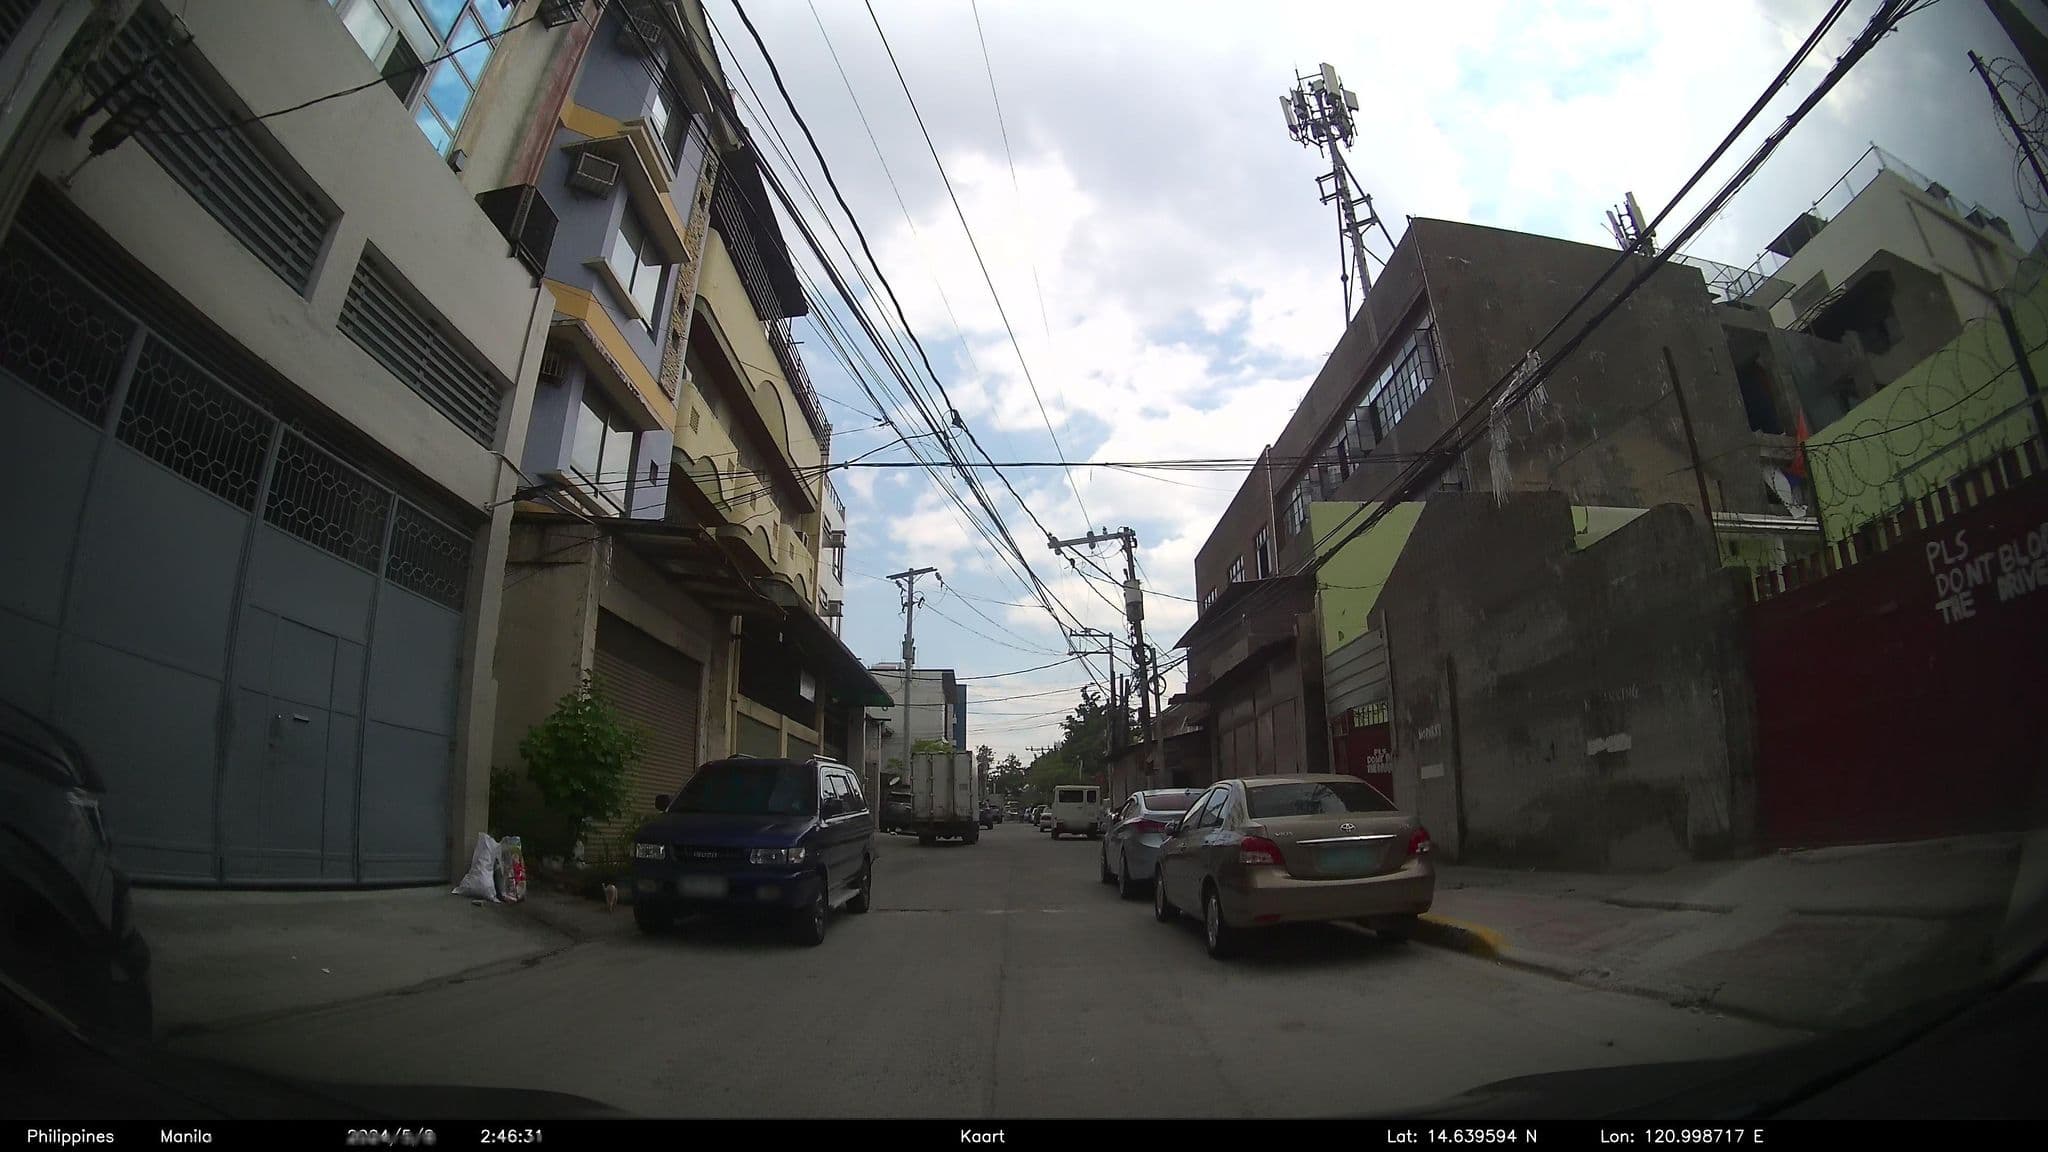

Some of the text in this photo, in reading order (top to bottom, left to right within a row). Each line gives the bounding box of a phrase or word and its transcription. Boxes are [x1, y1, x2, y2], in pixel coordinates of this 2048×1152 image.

[1926, 529, 1969, 575] PLS
[1935, 552, 1995, 599] DONT
[1935, 591, 1976, 624] THE
